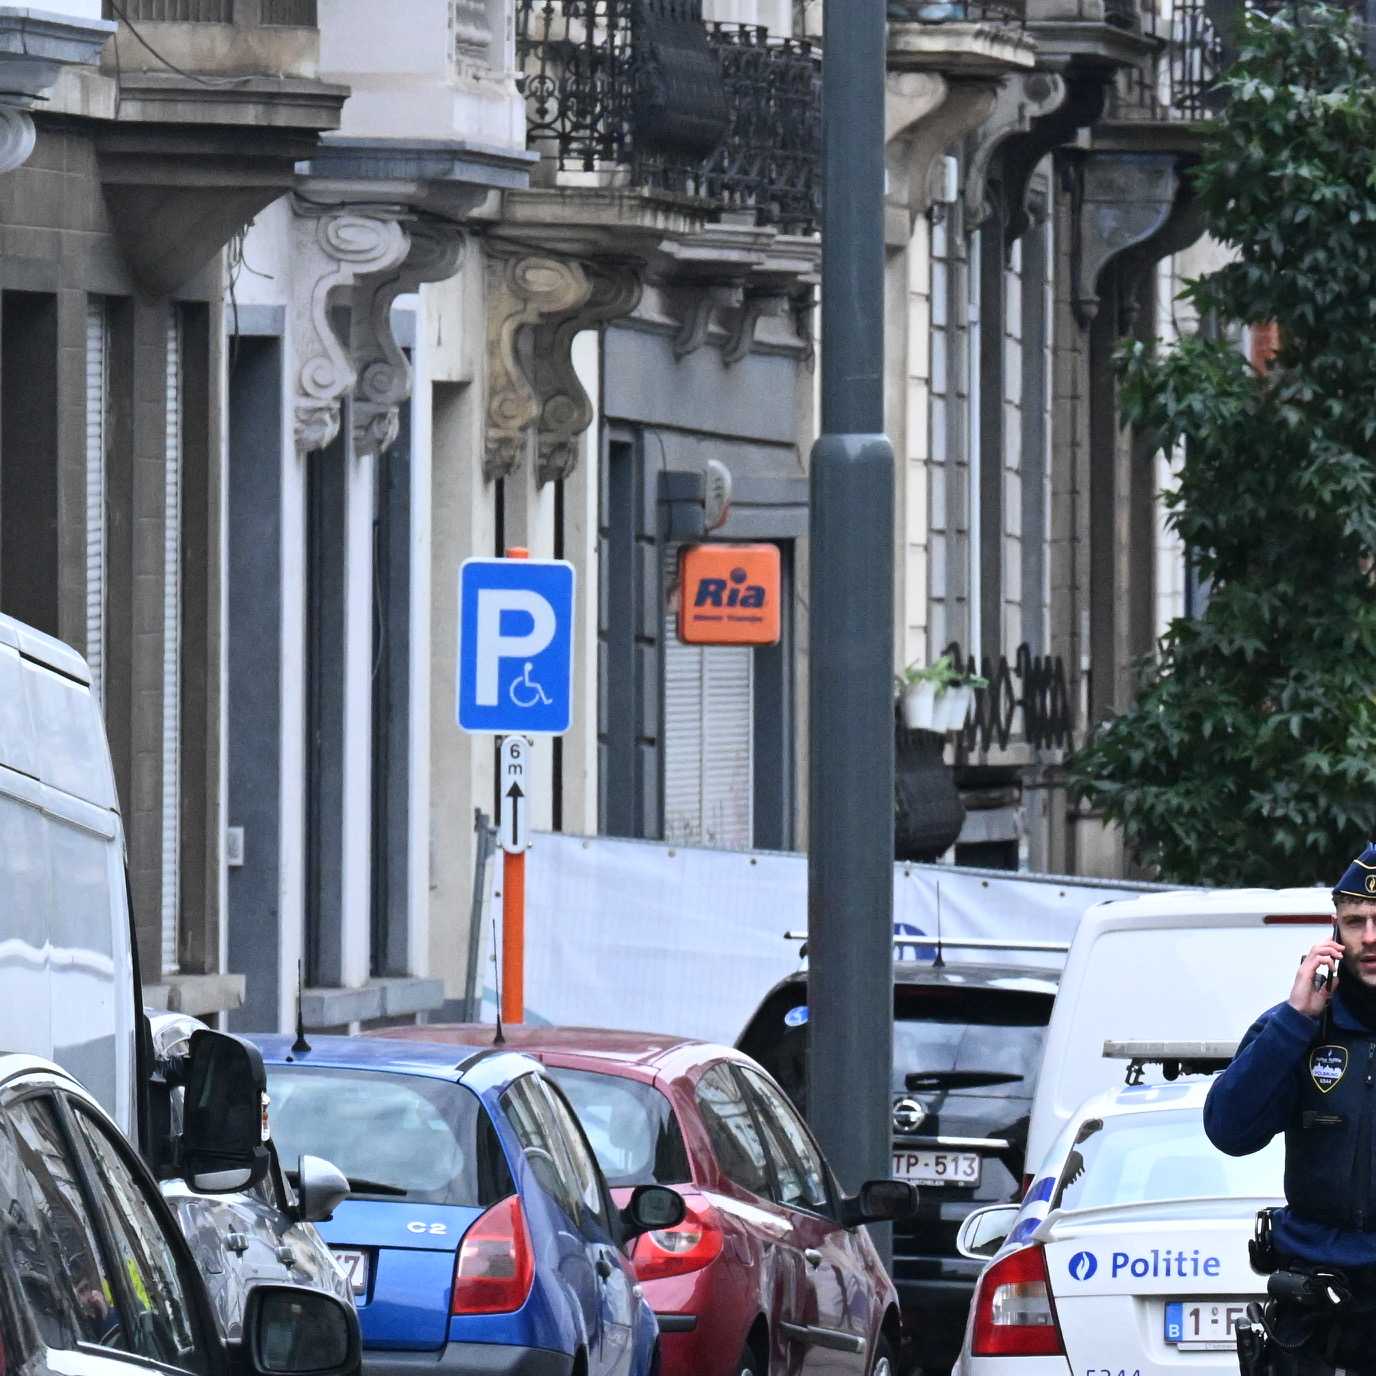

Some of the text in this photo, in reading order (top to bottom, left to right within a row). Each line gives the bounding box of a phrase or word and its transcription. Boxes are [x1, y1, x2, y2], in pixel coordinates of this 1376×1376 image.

[694, 567, 766, 608] Ria
[476, 588, 557, 707] P
[510, 743, 521, 759] 6
[508, 763, 523, 775] m
[893, 1153, 976, 1177] TP-513
[406, 1221, 449, 1235] C2
[1111, 1249, 1221, 1279] Politie
[1169, 1325, 1180, 1338] B
